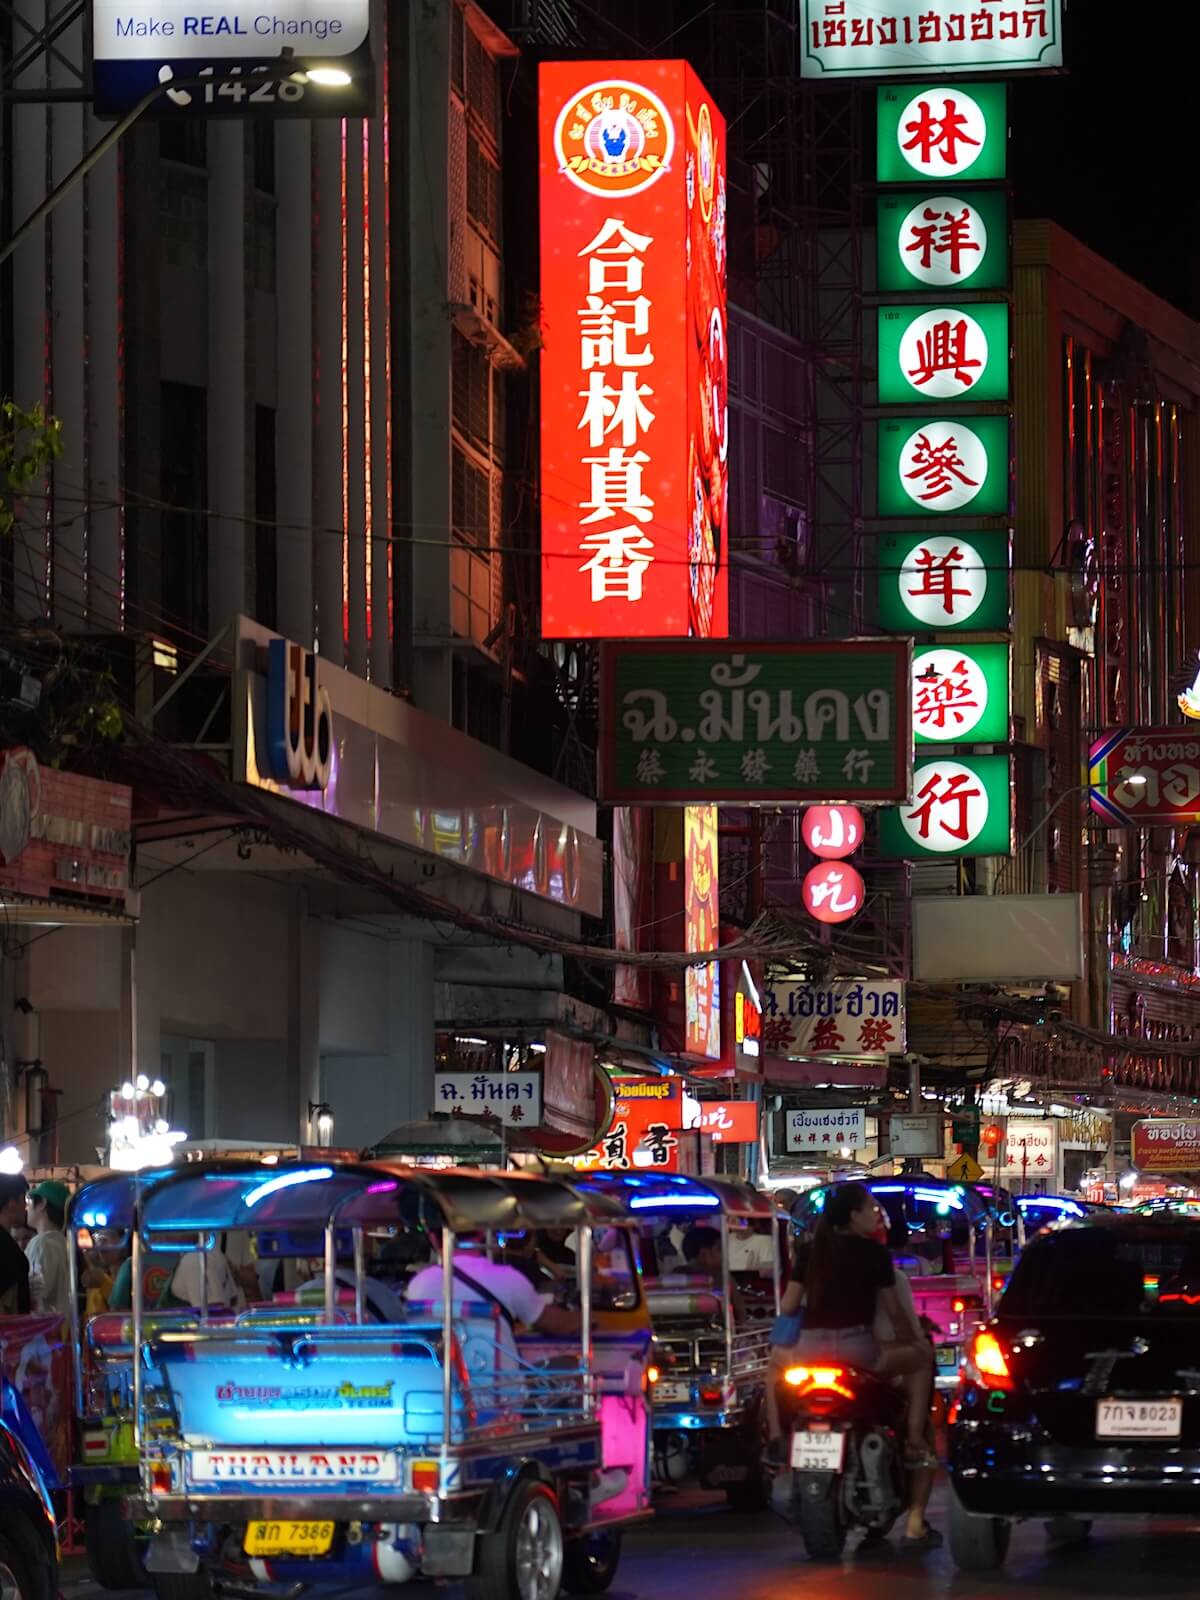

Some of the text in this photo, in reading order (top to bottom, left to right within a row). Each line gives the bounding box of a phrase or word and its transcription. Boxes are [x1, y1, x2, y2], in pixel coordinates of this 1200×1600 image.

[116, 15, 342, 39] Make REAL Change
[577, 218, 654, 602] 合記林真香
[622, 654, 890, 743] ฉ.มั่นคง
[1138, 1405, 1177, 1422] 8023
[208, 1455, 382, 1477] THAILAND
[290, 1522, 331, 1541] 7386
